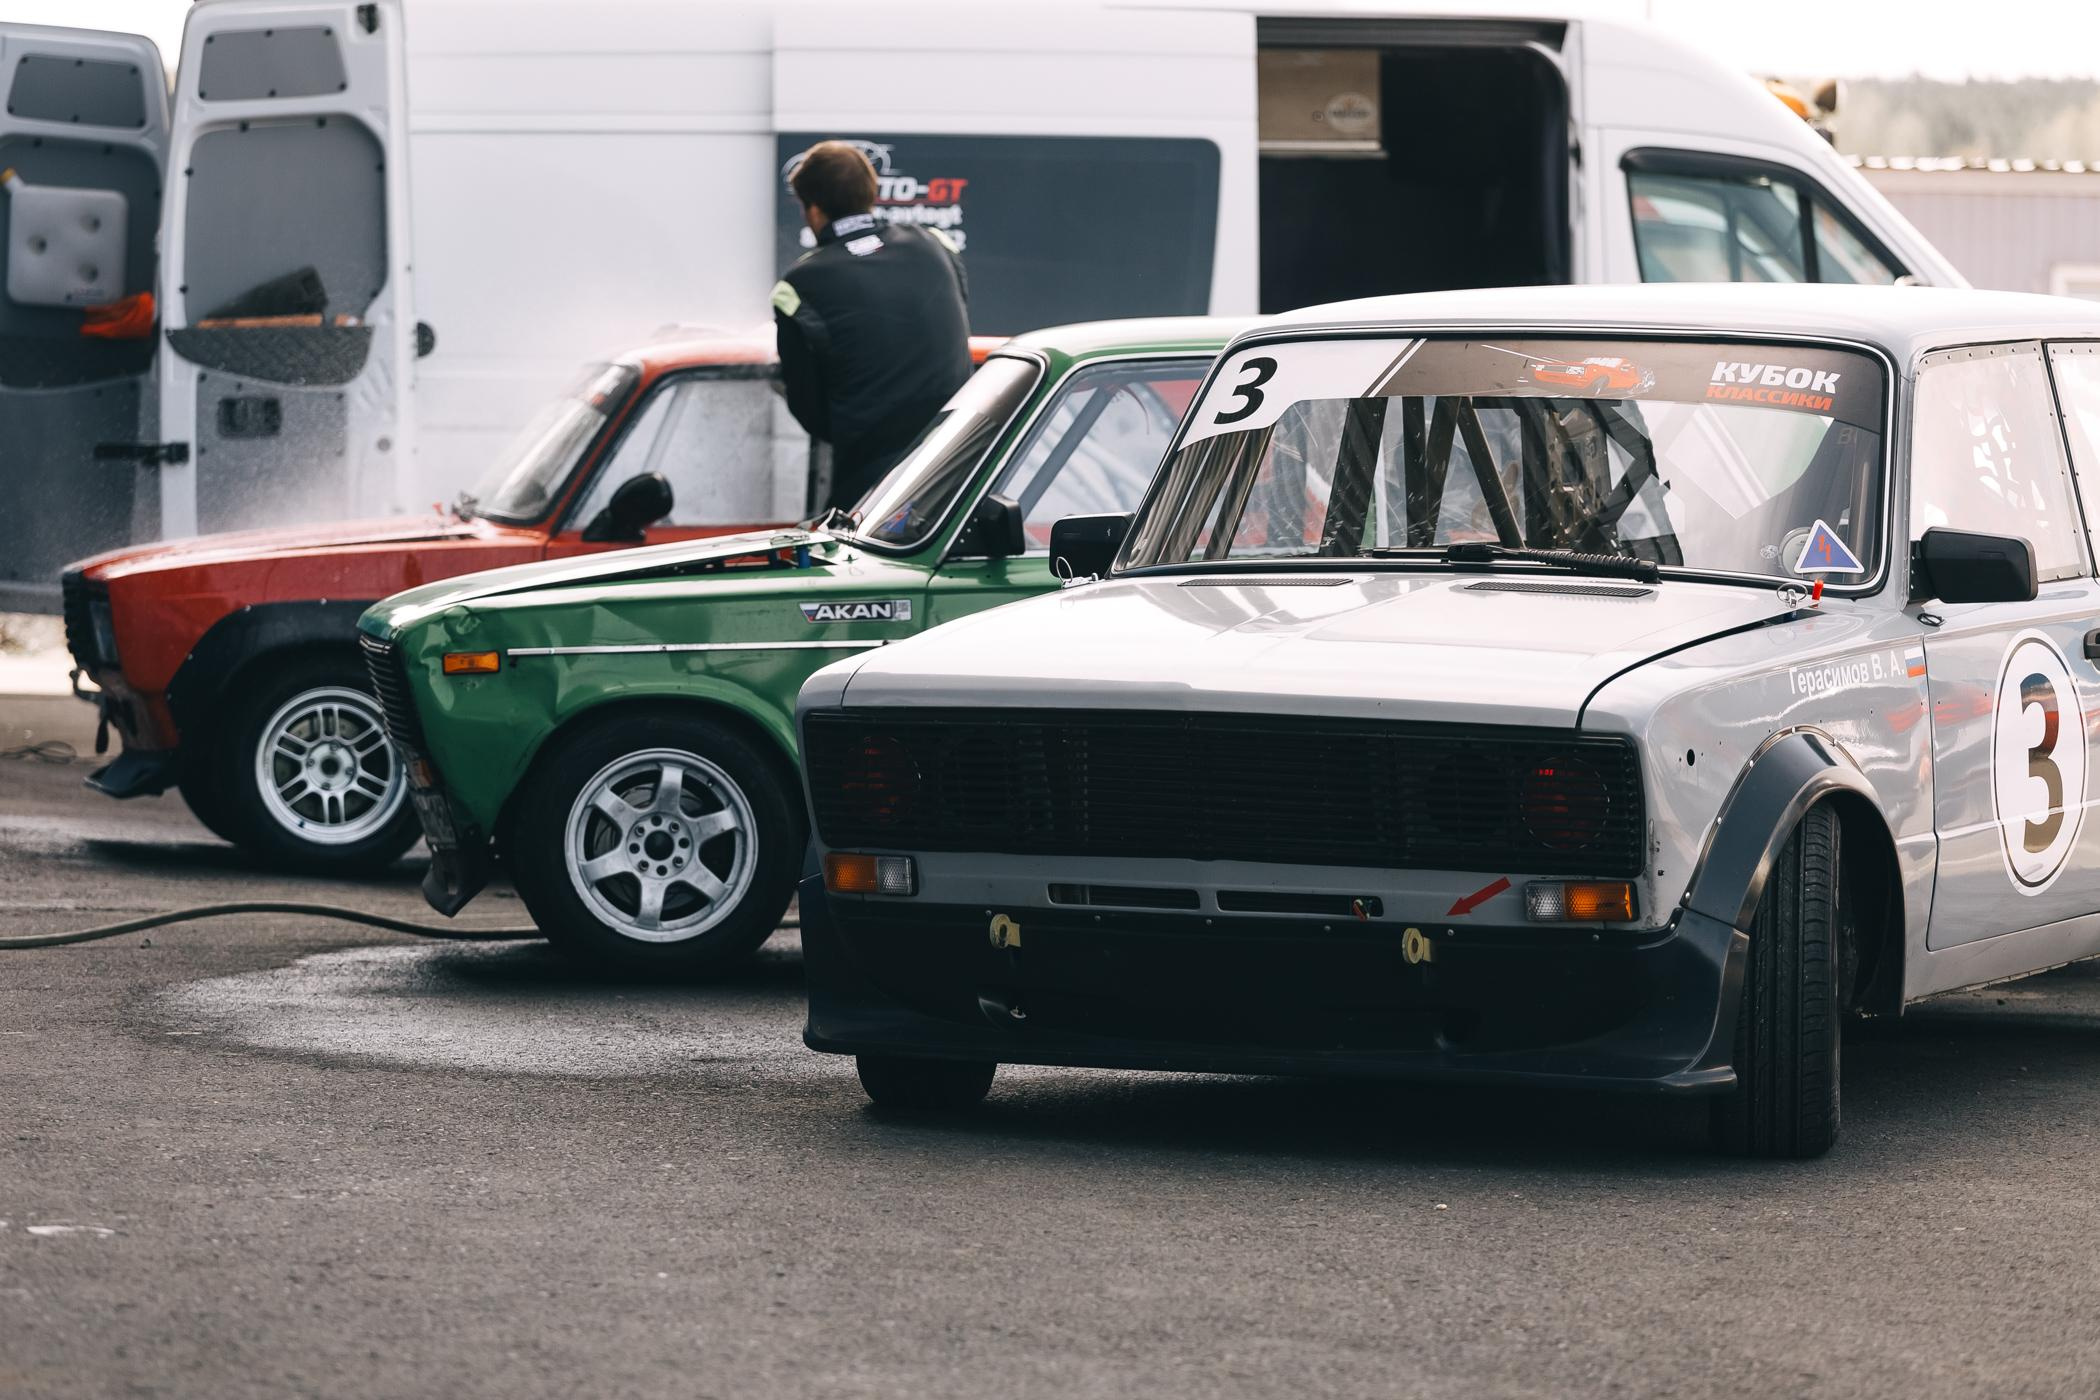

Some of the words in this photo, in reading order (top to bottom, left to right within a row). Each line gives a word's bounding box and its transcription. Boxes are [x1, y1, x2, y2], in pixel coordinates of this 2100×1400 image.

[875, 176, 968, 203] TO-GT
[1213, 356, 1279, 425] 3
[1711, 361, 1841, 394] КУБОК
[1706, 385, 1833, 411] КЛАССИКИ
[815, 603, 891, 620] AKAN
[1789, 666, 1869, 697] Герасимов
[1870, 653, 1888, 681] В.
[1890, 650, 1905, 677] А.
[2020, 672, 2064, 854] 3
